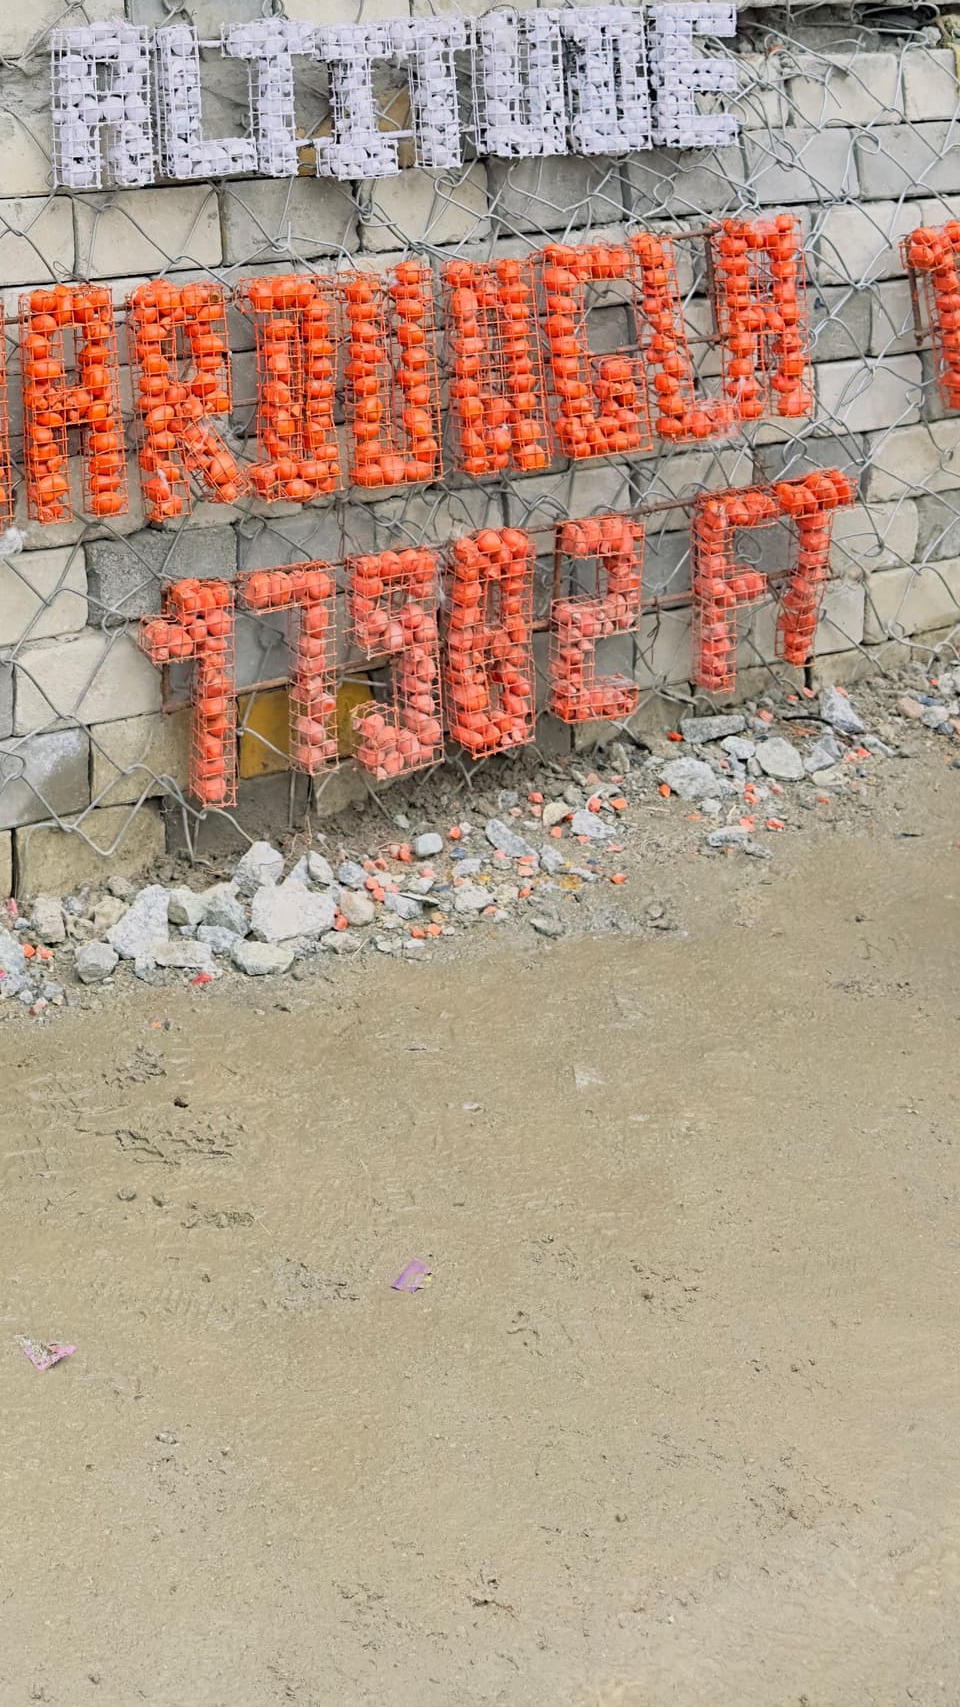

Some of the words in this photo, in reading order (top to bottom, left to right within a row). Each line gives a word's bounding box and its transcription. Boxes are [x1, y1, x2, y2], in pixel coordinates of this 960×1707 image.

[49, 1, 742, 190] ALTITUDE
[138, 513, 647, 809] 17582
[690, 466, 857, 694] FT
